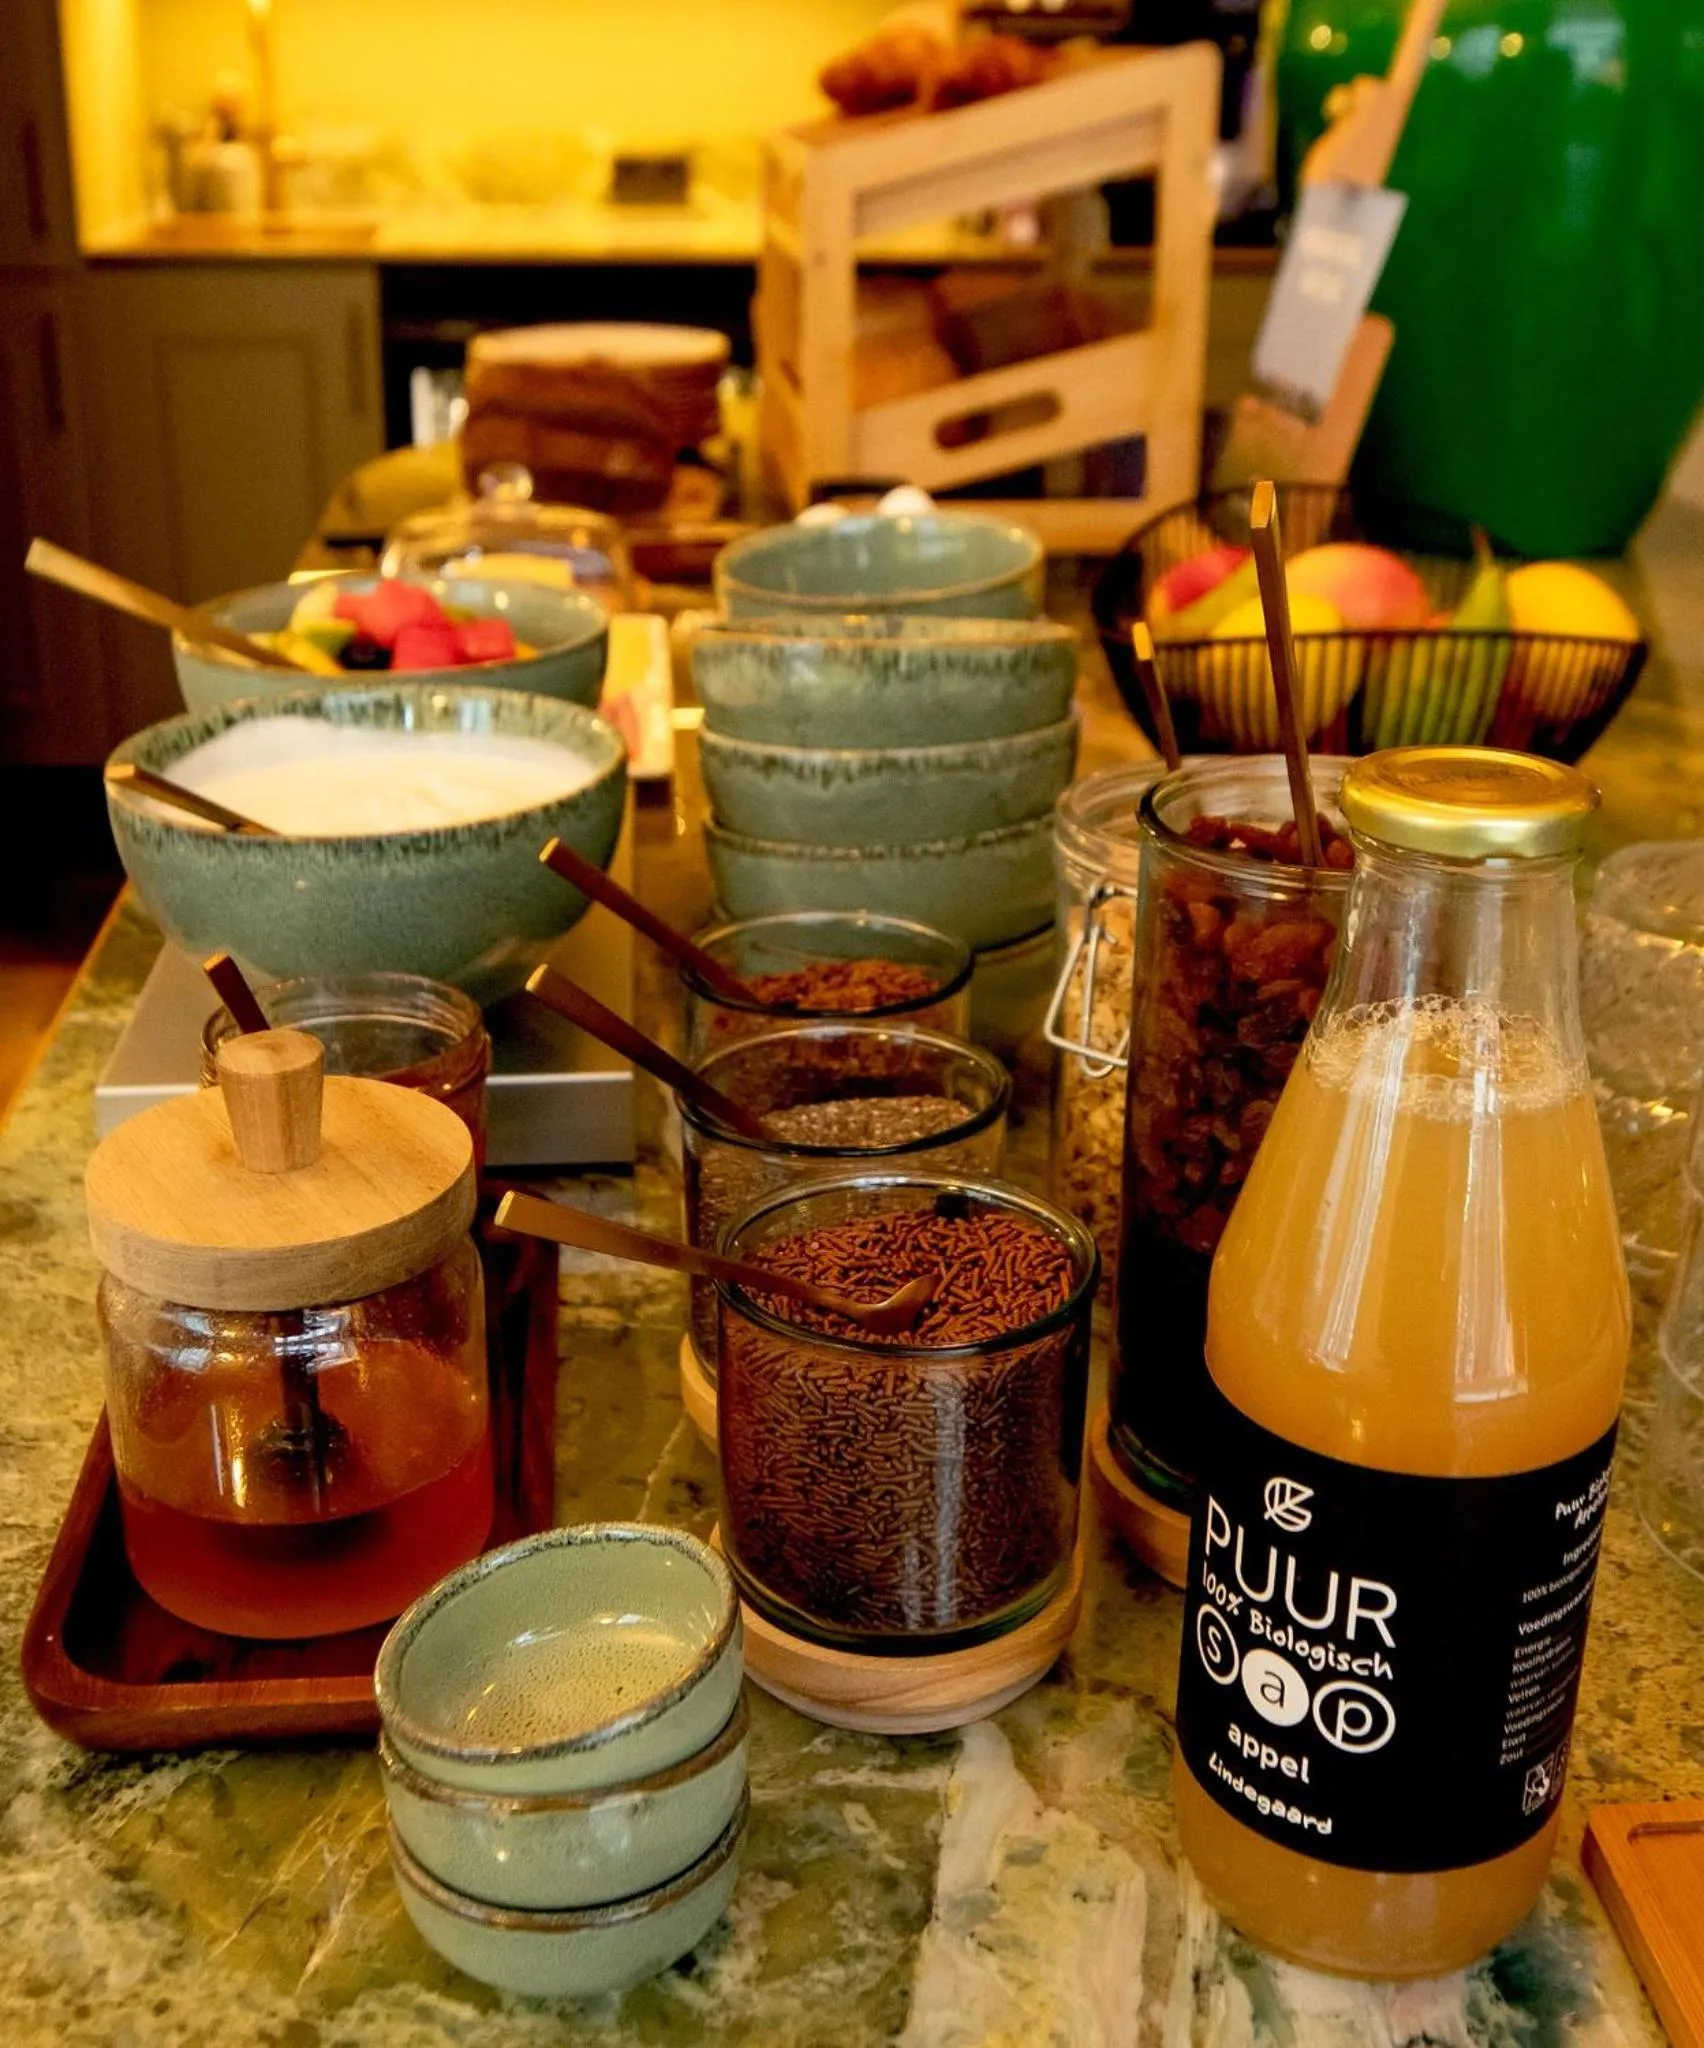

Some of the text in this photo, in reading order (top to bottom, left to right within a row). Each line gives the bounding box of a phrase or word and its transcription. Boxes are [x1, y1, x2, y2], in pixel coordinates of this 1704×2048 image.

[1555, 1494, 1586, 1520] Puur
[1205, 1494, 1397, 1648] PUUR
[1202, 1560, 1394, 1680] 100% Biologisch
[1208, 1751, 1333, 1835] Lindegaard
[1227, 1721, 1310, 1784] appel
